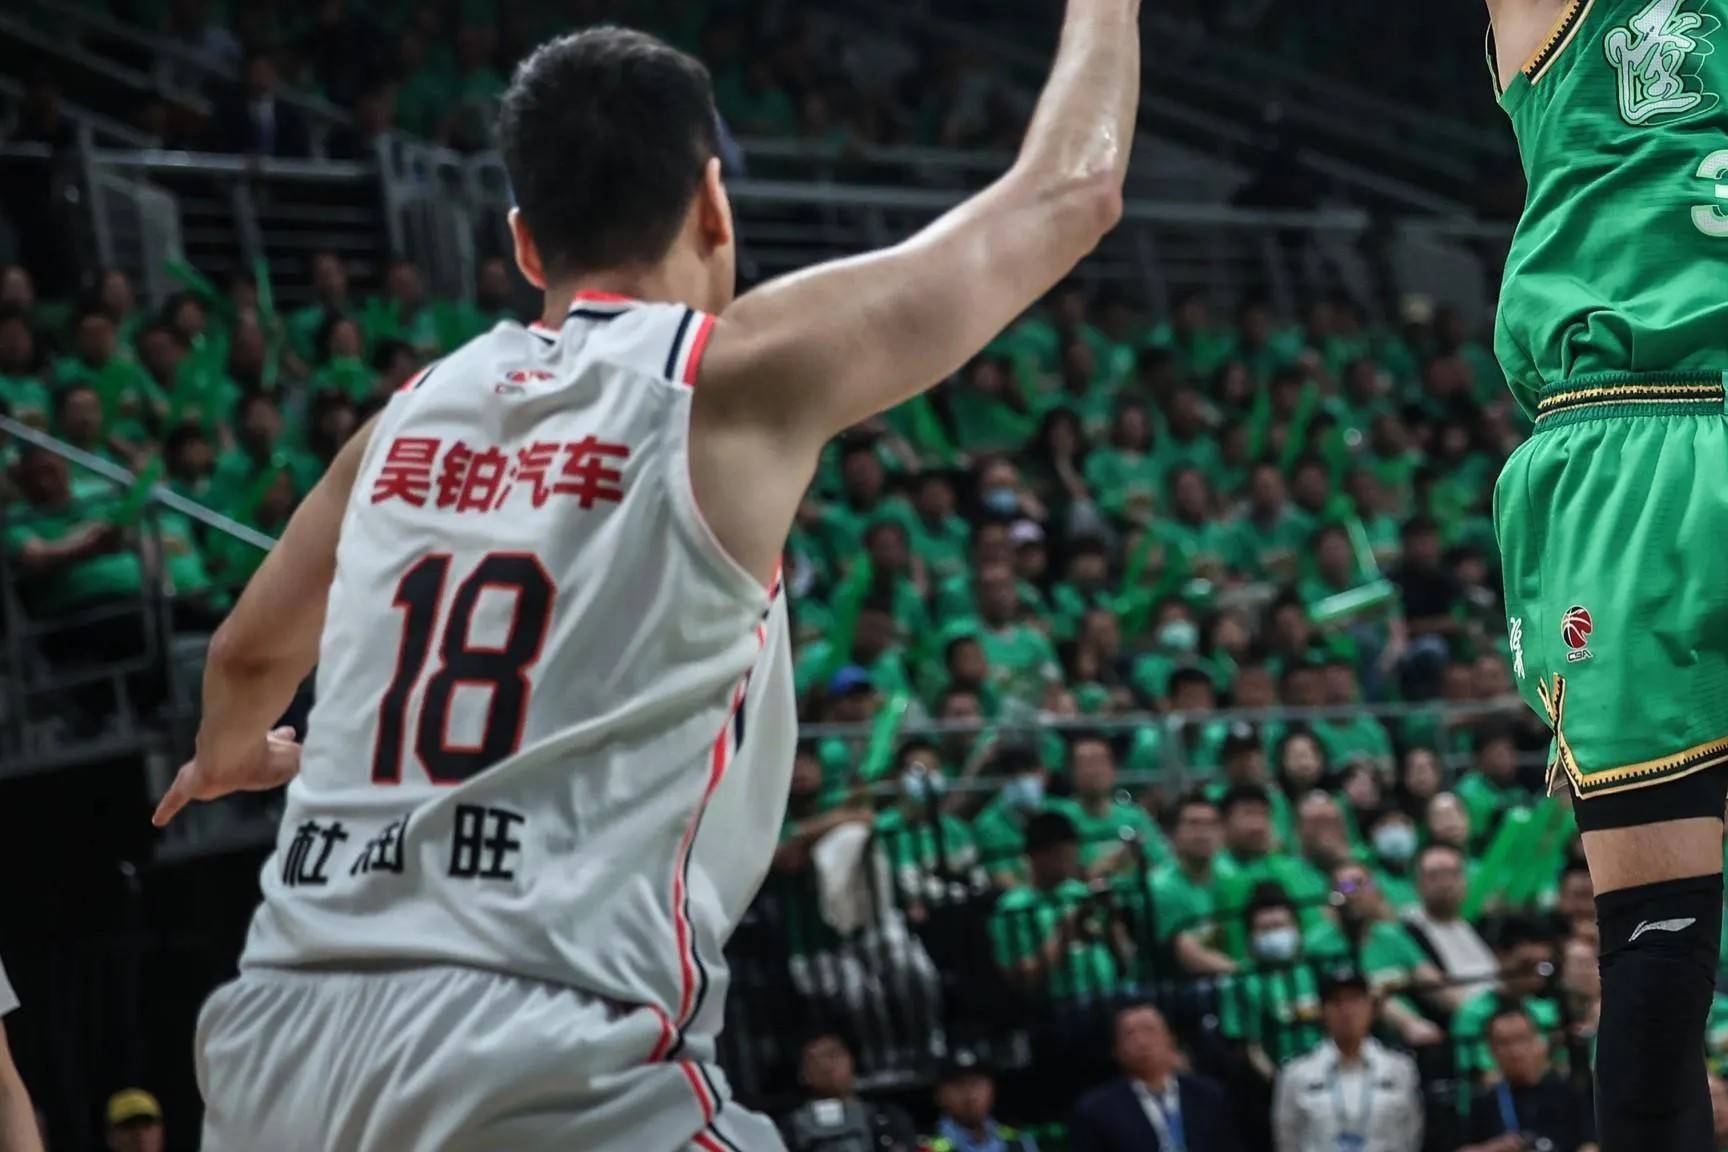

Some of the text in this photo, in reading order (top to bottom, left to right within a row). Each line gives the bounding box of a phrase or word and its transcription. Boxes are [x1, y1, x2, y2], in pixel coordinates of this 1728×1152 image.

[371, 435, 630, 512] 昊铂汽车
[371, 552, 558, 786] 18
